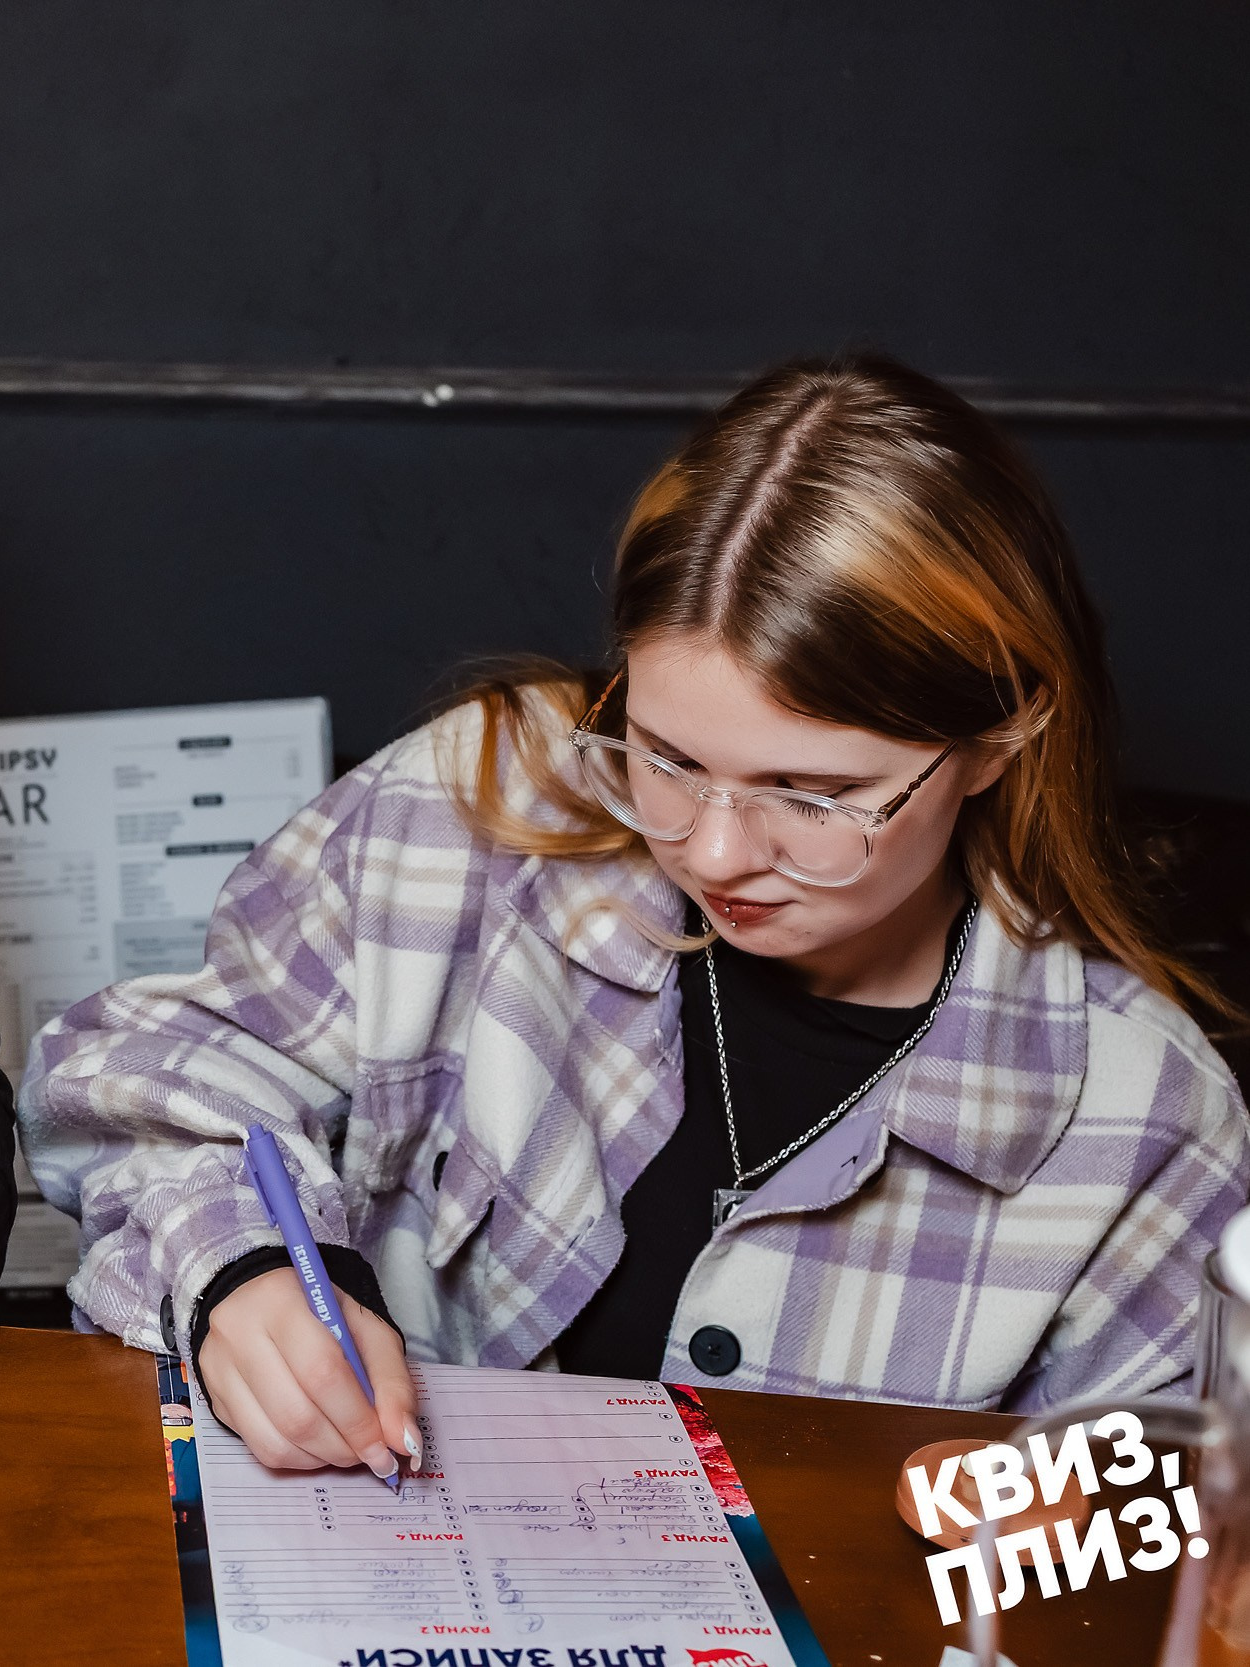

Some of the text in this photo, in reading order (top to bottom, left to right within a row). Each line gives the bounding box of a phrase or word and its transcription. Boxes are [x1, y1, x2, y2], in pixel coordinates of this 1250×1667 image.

[293, 1244, 331, 1322] КВИЗ, ПЛИЗ!
[616, 1398, 667, 1406] РАУНД
[399, 1471, 445, 1479] РАУН
[633, 1468, 699, 1478] РАУНД 5
[409, 1533, 463, 1541] РАУНД
[661, 1534, 728, 1543] РАУНД 3
[420, 1625, 491, 1634] РАУНД 2
[702, 1625, 772, 1635] РАУНД 1
[567, 1645, 666, 1667] ДЛЯ
